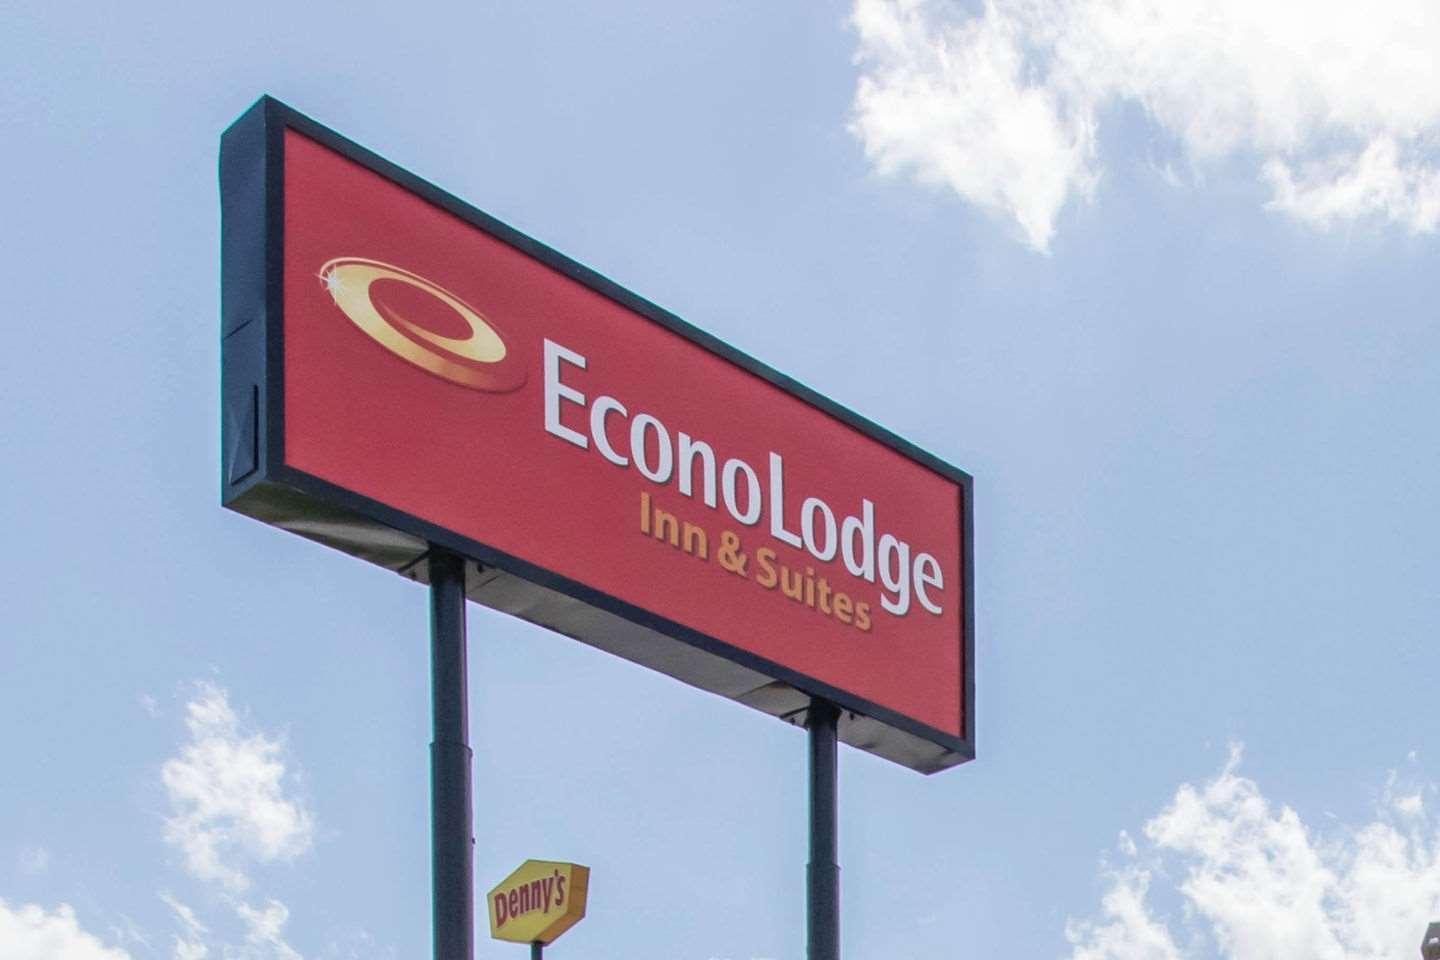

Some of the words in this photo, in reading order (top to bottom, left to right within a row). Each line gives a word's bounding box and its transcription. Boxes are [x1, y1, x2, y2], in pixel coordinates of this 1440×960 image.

[544, 338, 945, 616] EconoLodge
[640, 492, 708, 560] Inn
[717, 530, 748, 577] &
[756, 547, 872, 632] Suites
[494, 868, 566, 928] Denny's
